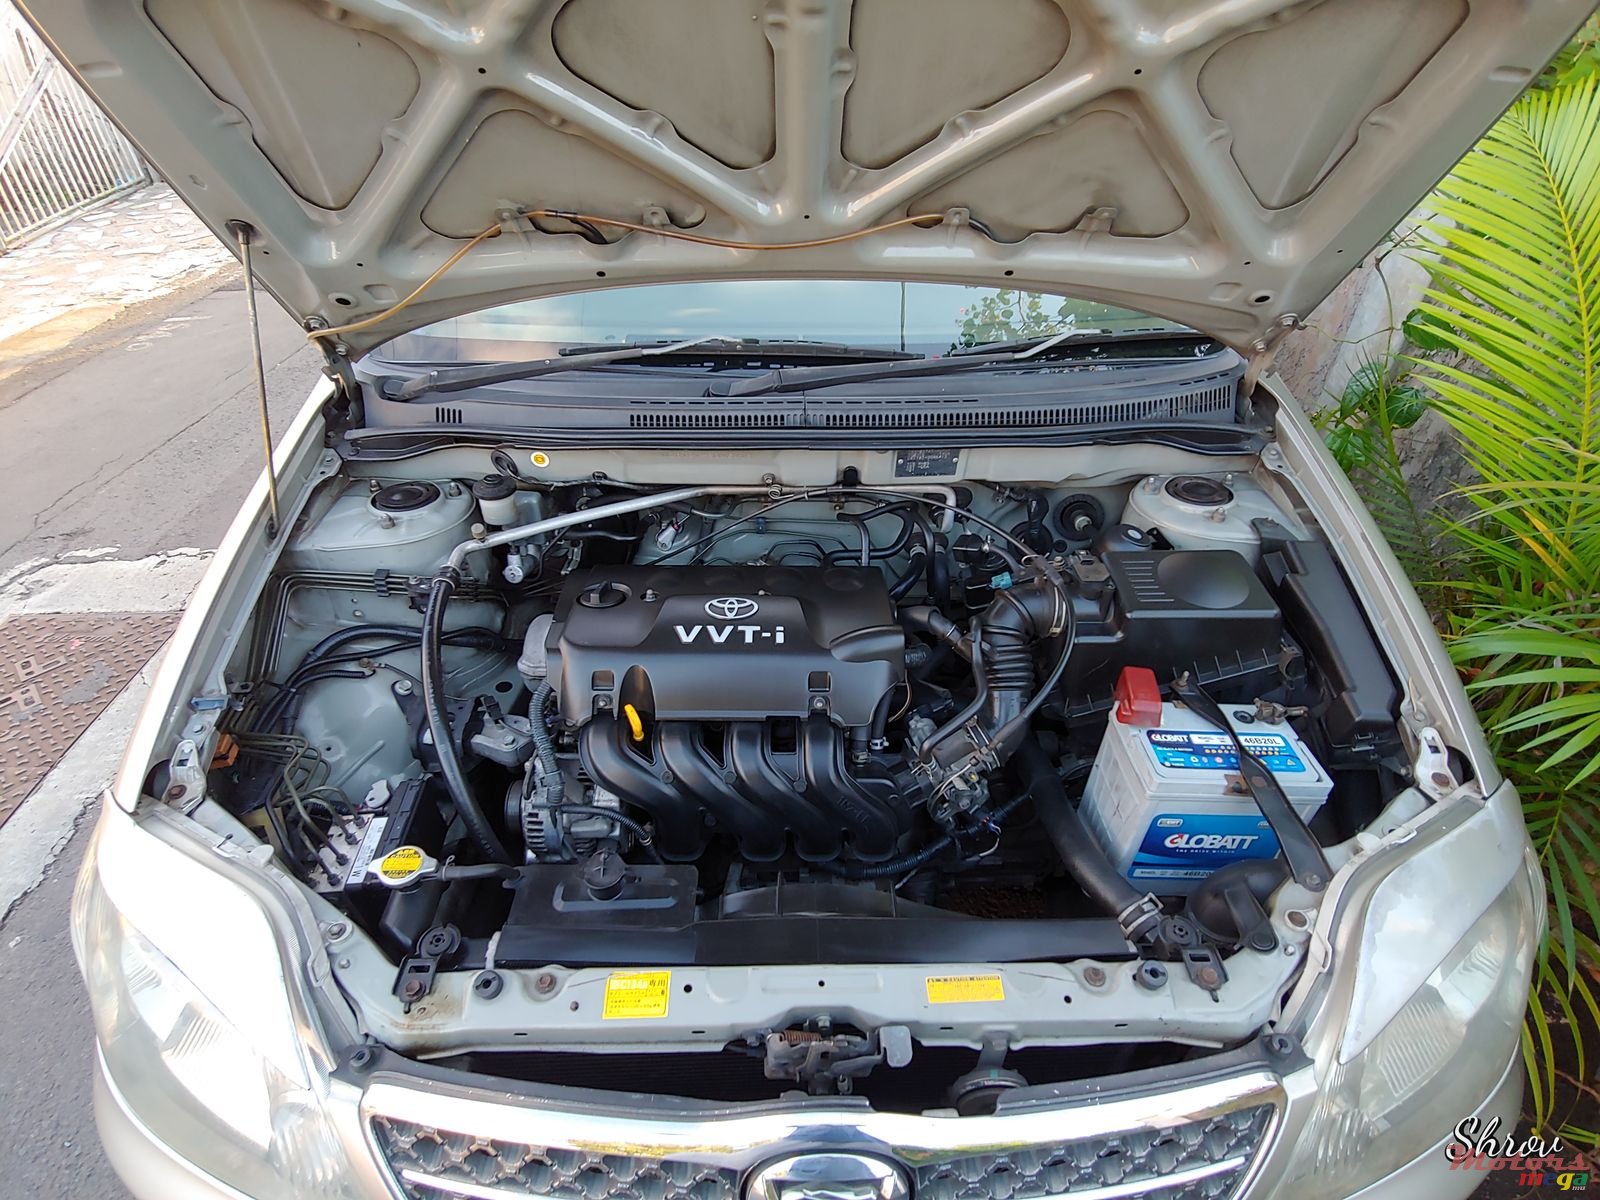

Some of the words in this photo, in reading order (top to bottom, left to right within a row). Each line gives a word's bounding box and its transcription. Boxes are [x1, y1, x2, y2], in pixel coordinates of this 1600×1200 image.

[674, 625, 785, 643] VVT-i
[1151, 733, 1189, 743] GLOBATT
[1243, 735, 1281, 745] 46B20L
[1164, 833, 1258, 849] GLOBATT
